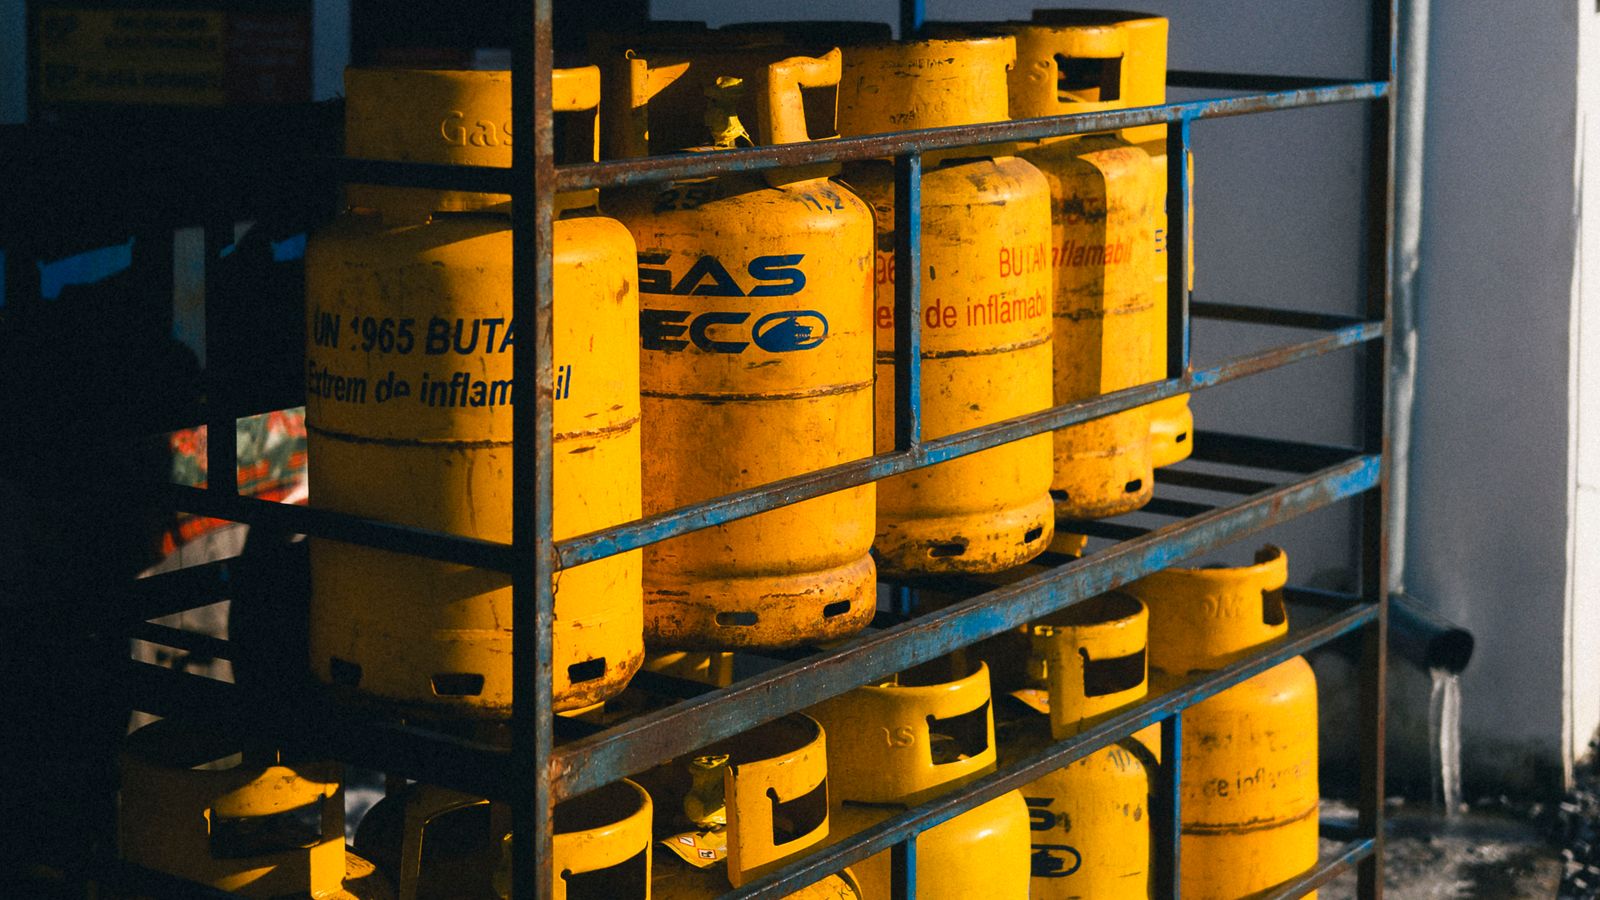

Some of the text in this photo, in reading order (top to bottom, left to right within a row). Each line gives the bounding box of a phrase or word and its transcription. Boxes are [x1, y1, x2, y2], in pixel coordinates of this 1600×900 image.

[1052, 236, 1134, 268] nflamabil
[638, 252, 807, 297] GAS
[925, 298, 957, 329] de
[967, 286, 1047, 327] inflamabil
[313, 306, 340, 349] UN
[425, 318, 514, 356] BUTA
[639, 308, 829, 354] ECO
[420, 365, 572, 407] inflamil
